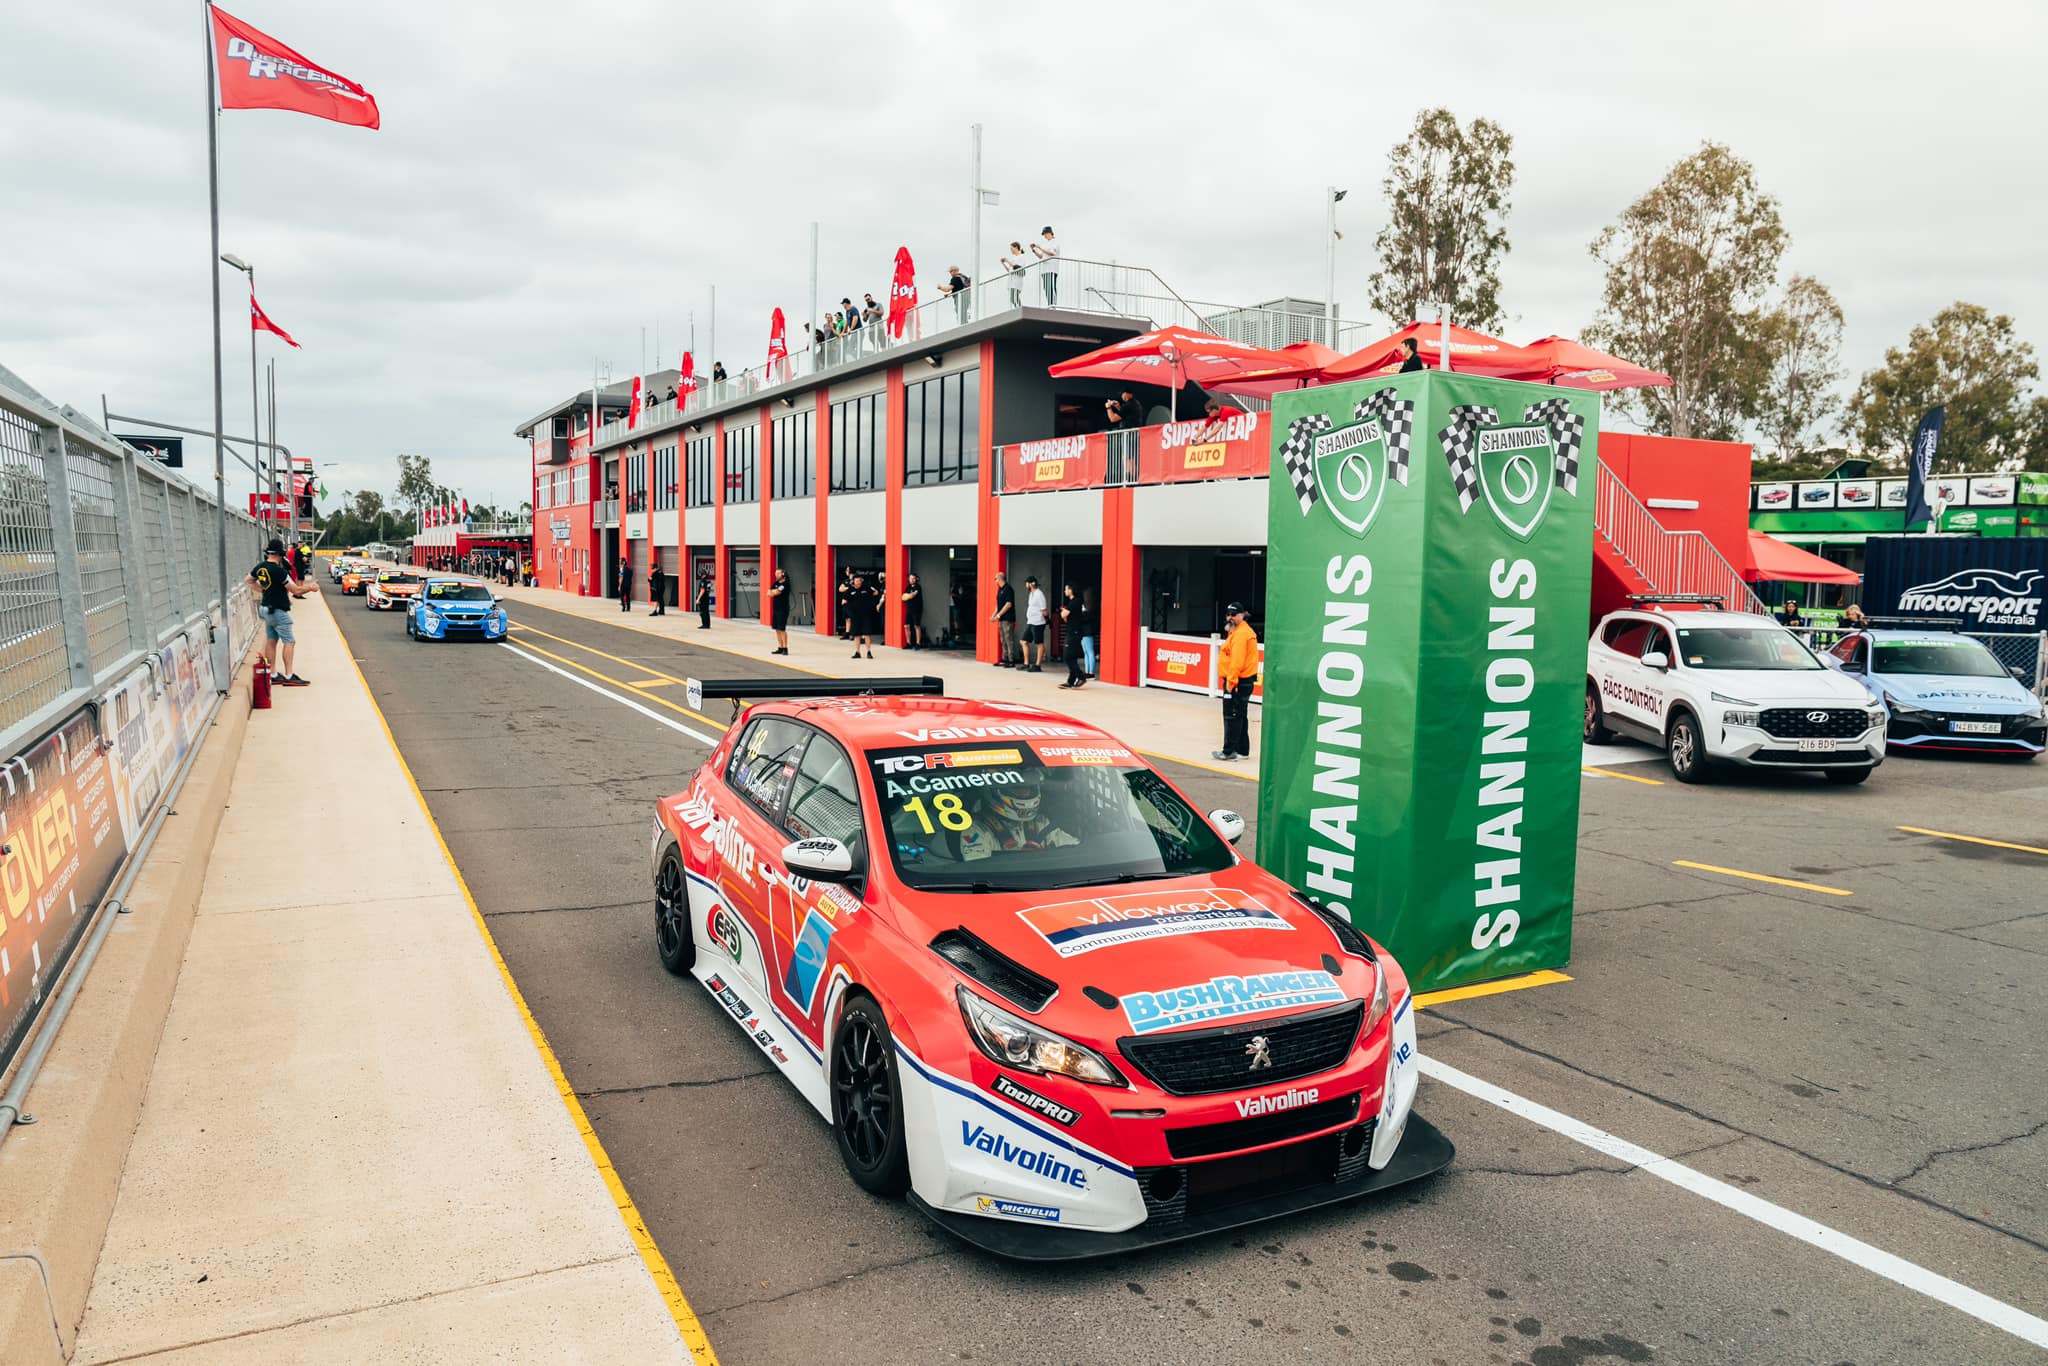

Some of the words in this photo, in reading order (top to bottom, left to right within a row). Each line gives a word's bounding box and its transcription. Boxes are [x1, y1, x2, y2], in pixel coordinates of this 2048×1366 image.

[1020, 435, 1087, 465] SUPERCHEAP
[1318, 422, 1379, 456] SHANNONS
[1481, 428, 1547, 452] SHANNONS
[1189, 449, 1220, 463] AUTO
[1039, 465, 1060, 476] AUTO
[1897, 593, 2042, 623] motorsport
[1986, 613, 2036, 625] australia
[1157, 648, 1201, 666] SUPERCHEAP
[1603, 679, 1622, 701] RACE
[1916, 691, 1983, 699] SAFETY
[896, 725, 1079, 743] Valvoline
[1800, 740, 1815, 749] 216
[874, 752, 955, 775] TCR
[956, 752, 1017, 764] Australia
[1040, 747, 1132, 759] SUPERCHEAP
[1471, 558, 1537, 950] SHANNONS
[886, 768, 1025, 799] A.Cameron
[902, 792, 973, 835] 18
[673, 782, 756, 886] Valvoline
[1, 787, 77, 921] OVER
[819, 899, 836, 915] AUTO
[1076, 889, 1235, 925] villawood
[1151, 910, 1246, 925] properties
[1059, 928, 1162, 956] Communities
[1162, 921, 1224, 936] Designed
[1224, 919, 1249, 929] for
[1249, 919, 1291, 930] Living
[1122, 973, 1338, 1022] BUSHRANGER
[1168, 1009, 1220, 1024] POWER
[1231, 996, 1318, 1013] EQUIPMENT
[996, 1077, 1074, 1124] ToolPRO
[1235, 1088, 1320, 1119] Valvoline
[961, 1120, 1088, 1189] Valvoline
[1000, 1203, 1059, 1218] MICHELIN
